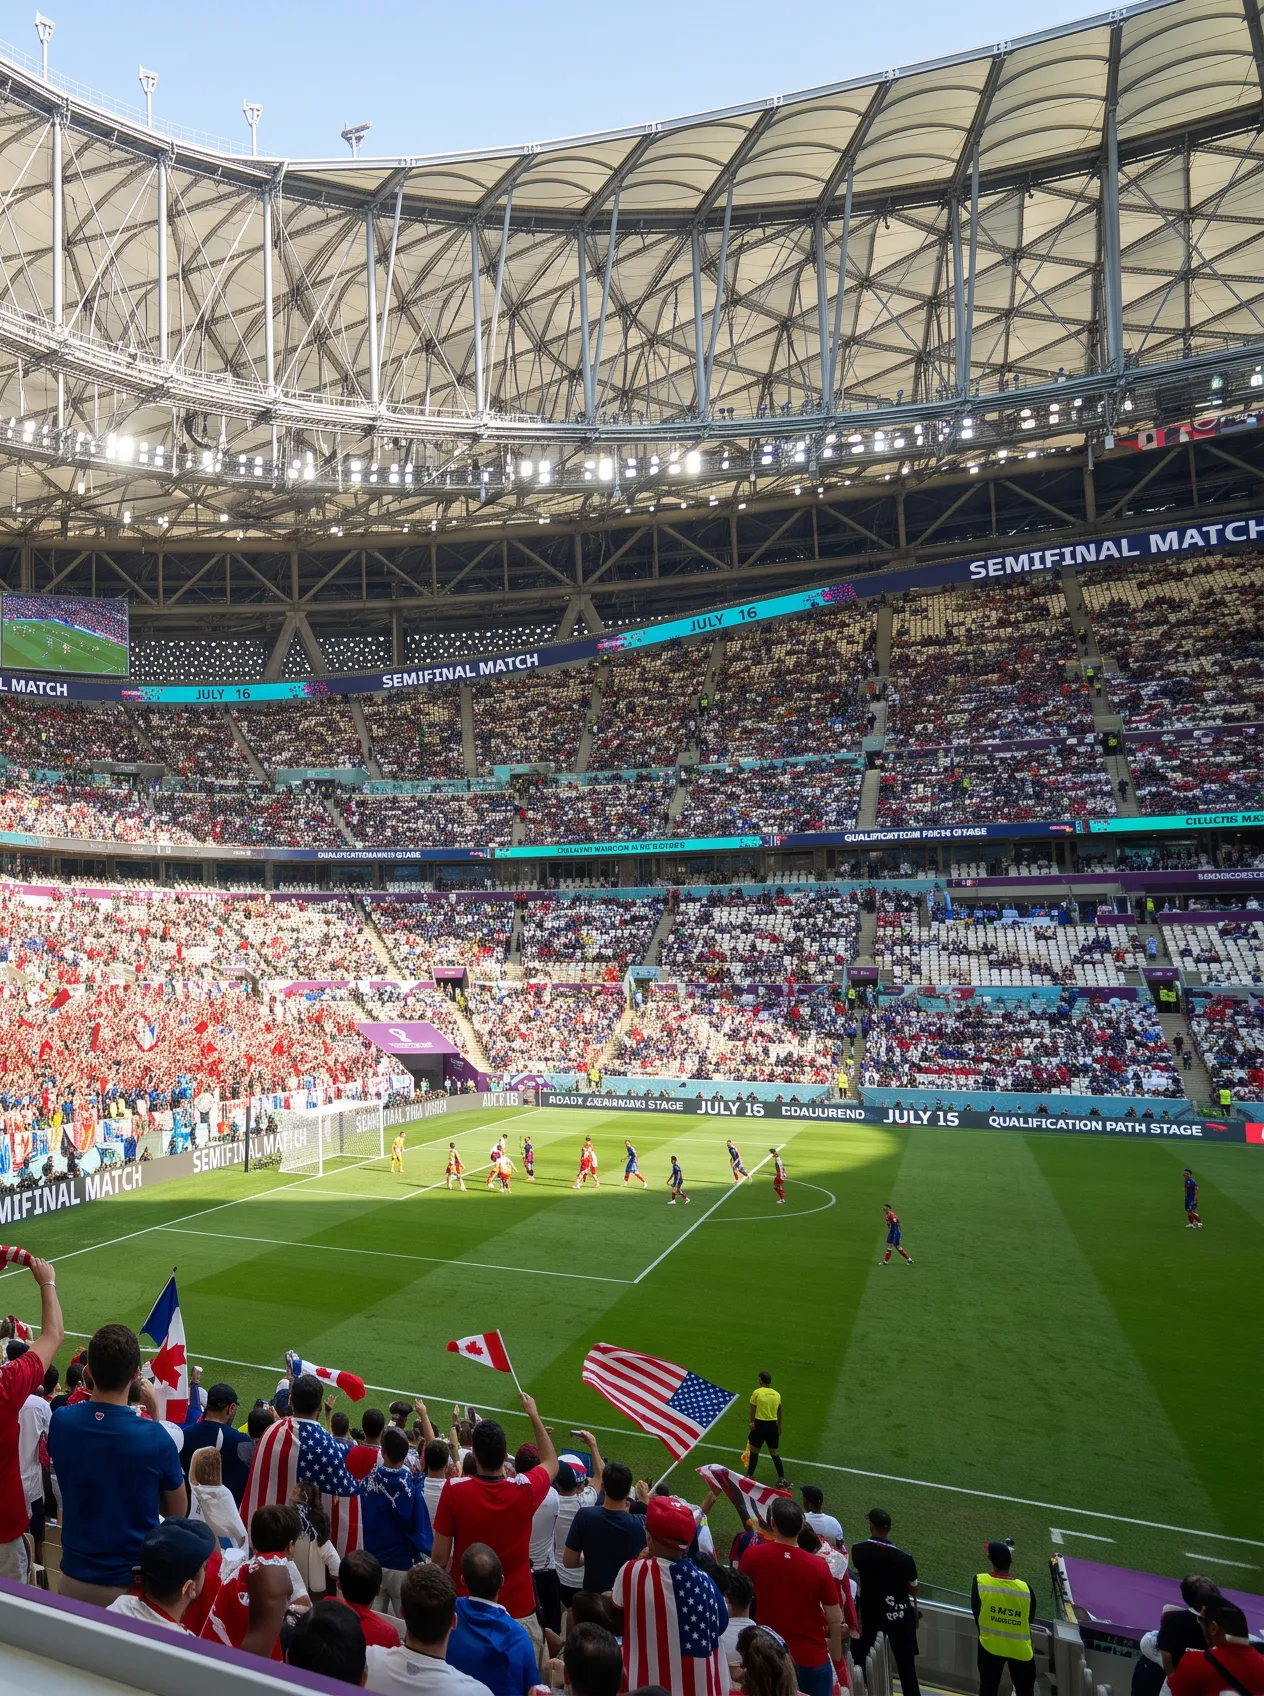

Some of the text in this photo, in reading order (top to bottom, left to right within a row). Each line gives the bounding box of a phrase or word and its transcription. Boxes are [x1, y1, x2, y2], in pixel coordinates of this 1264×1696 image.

[969, 519, 1264, 580] SEMIFINAL MATCH
[690, 606, 758, 632] JULY 16
[382, 653, 539, 688] SEMIFINAL MATCH
[11, 678, 68, 696] MATCH
[195, 688, 251, 700] JULY 16
[648, 1100, 684, 1110] STAGE
[697, 1100, 740, 1115] JULY
[883, 1109, 932, 1125] JULY
[988, 1116, 1203, 1136] QUALIFICATION PATH STAGE
[193, 1137, 262, 1173] SEMIFINAL
[85, 1165, 143, 1202] MATCH
